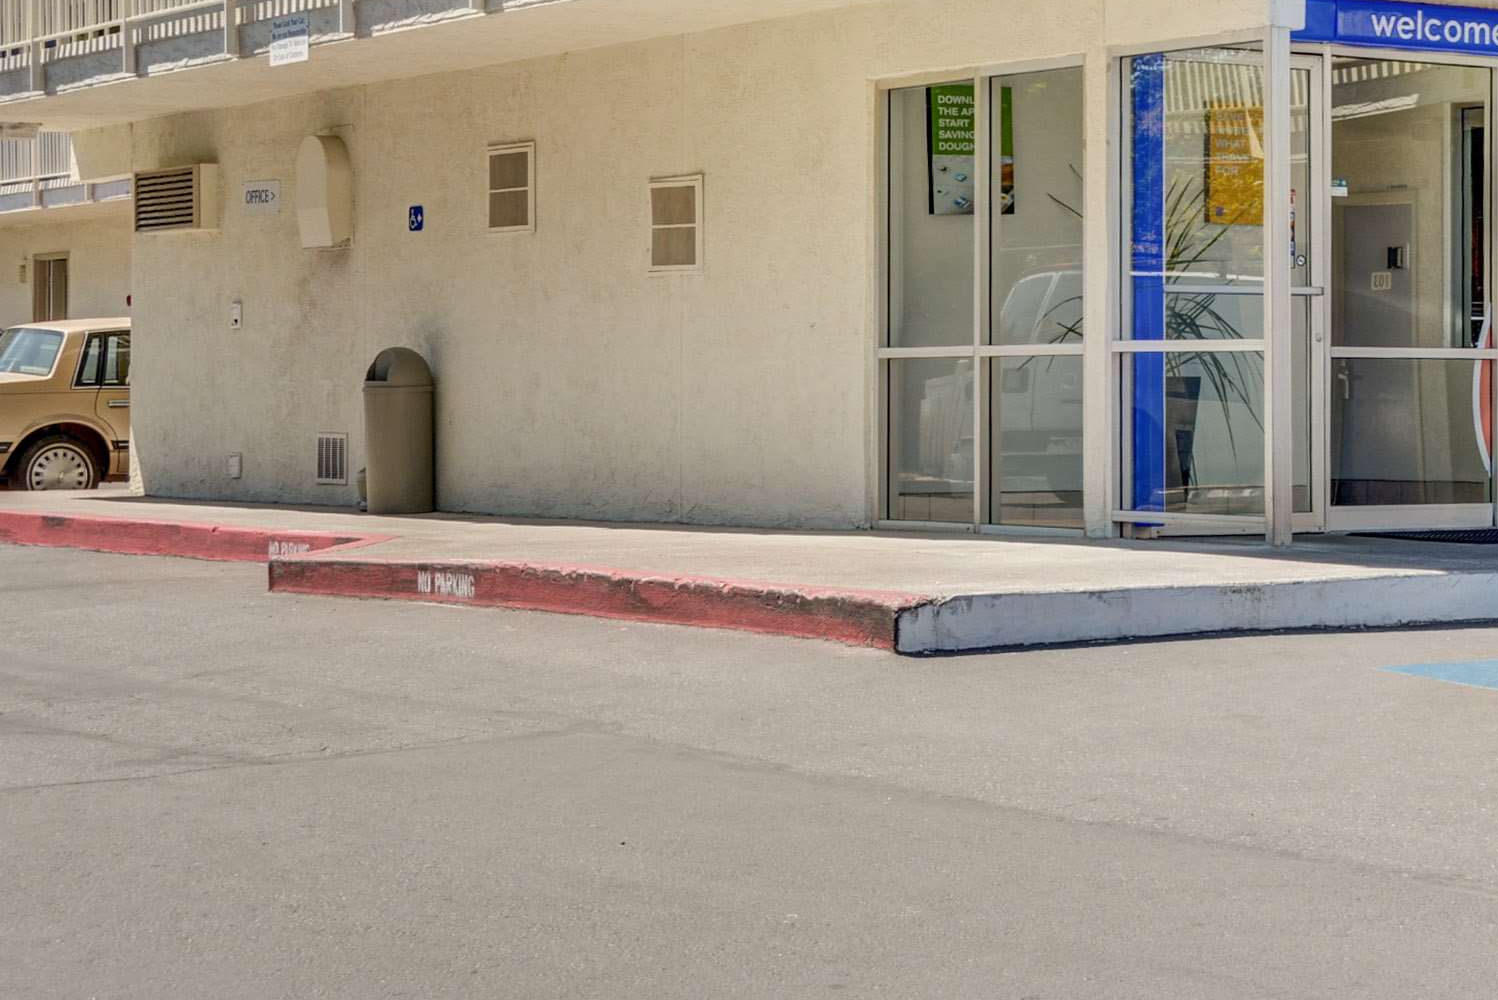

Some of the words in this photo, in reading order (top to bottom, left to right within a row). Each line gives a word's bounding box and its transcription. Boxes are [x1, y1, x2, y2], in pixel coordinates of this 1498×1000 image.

[939, 107, 959, 116] THE
[939, 119, 968, 127] START
[245, 190, 269, 204] OFFICE
[417, 570, 431, 592] NO
[434, 571, 475, 598] PARKING
